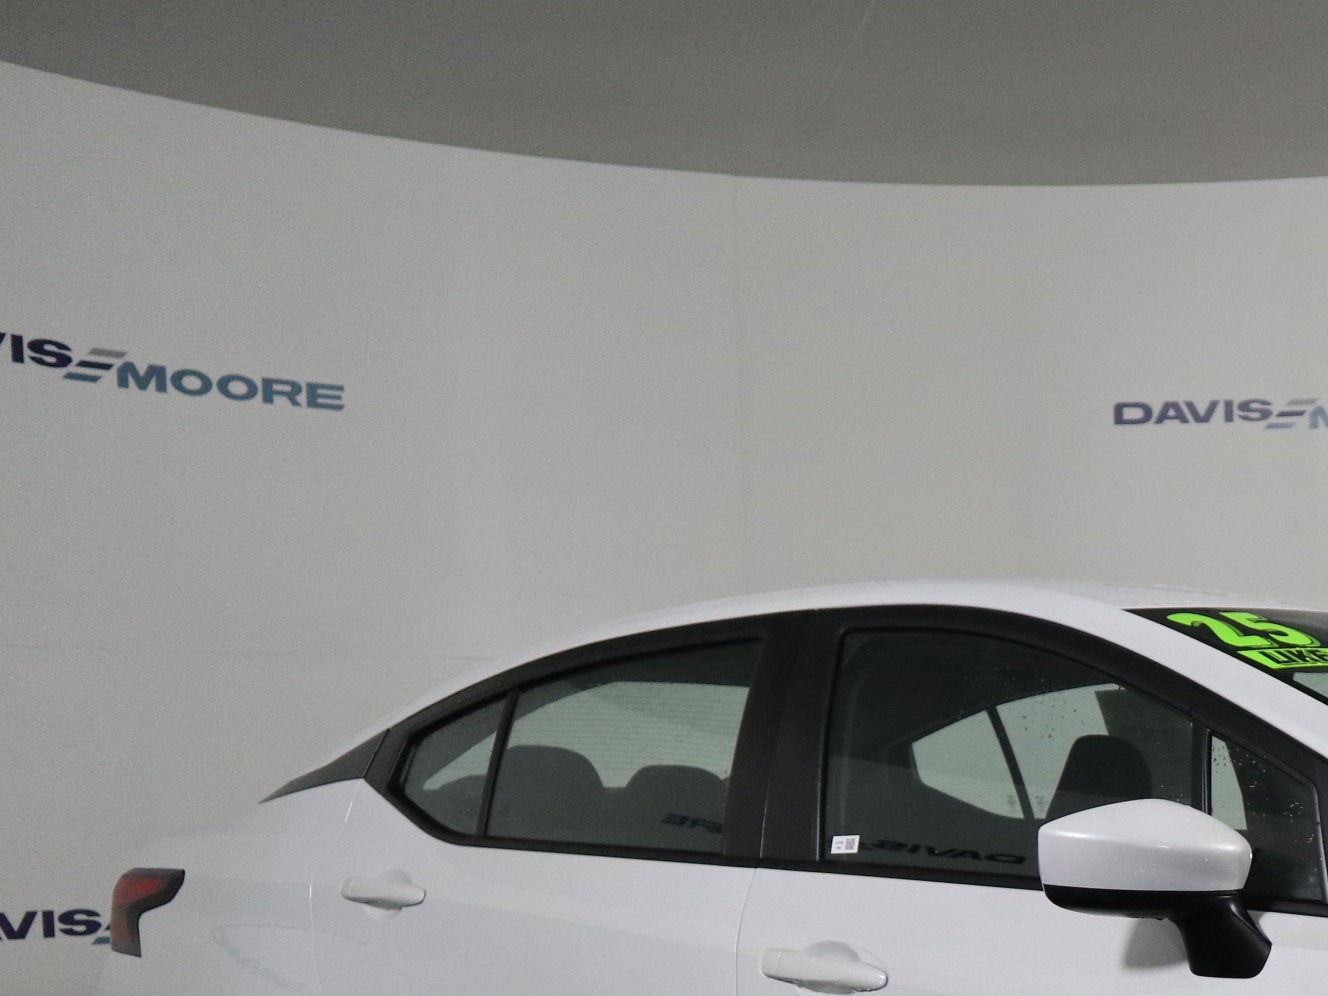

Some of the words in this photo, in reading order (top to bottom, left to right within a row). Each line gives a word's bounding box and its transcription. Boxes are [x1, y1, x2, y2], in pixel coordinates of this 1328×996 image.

[0, 331, 73, 369] IS
[116, 359, 345, 412] MOORE
[1113, 399, 1273, 426] DAVIS
[1166, 611, 1321, 648] 25
[0, 908, 102, 941] VIS
